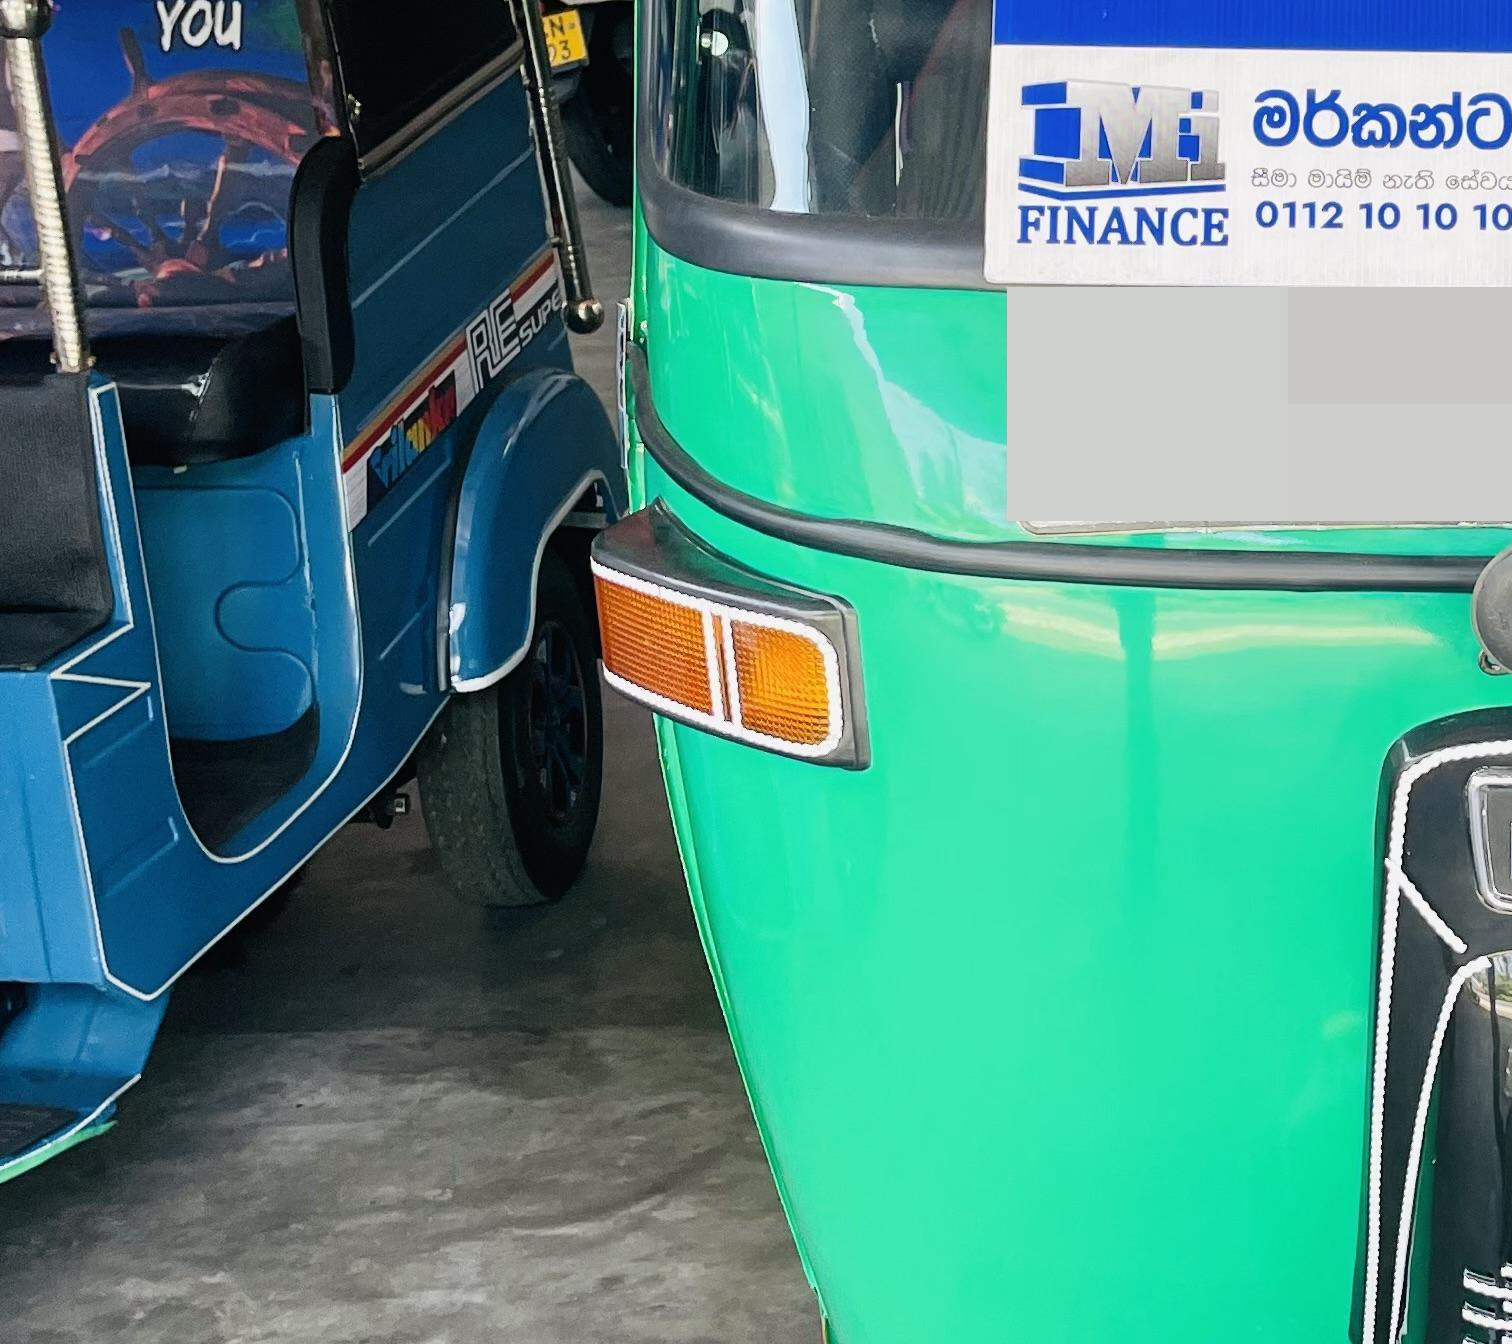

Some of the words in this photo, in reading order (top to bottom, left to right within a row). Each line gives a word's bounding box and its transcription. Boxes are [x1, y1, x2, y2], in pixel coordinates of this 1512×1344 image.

[1251, 167, 1297, 189] සීමා
[1307, 167, 1373, 189] මායිම්
[1382, 169, 1435, 190] නැති
[1017, 205, 1230, 247] FINANCE
[1255, 200, 1344, 229] 0112
[1358, 202, 1402, 230] 10
[1415, 202, 1458, 231] 10
[519, 292, 565, 348] SUPE
